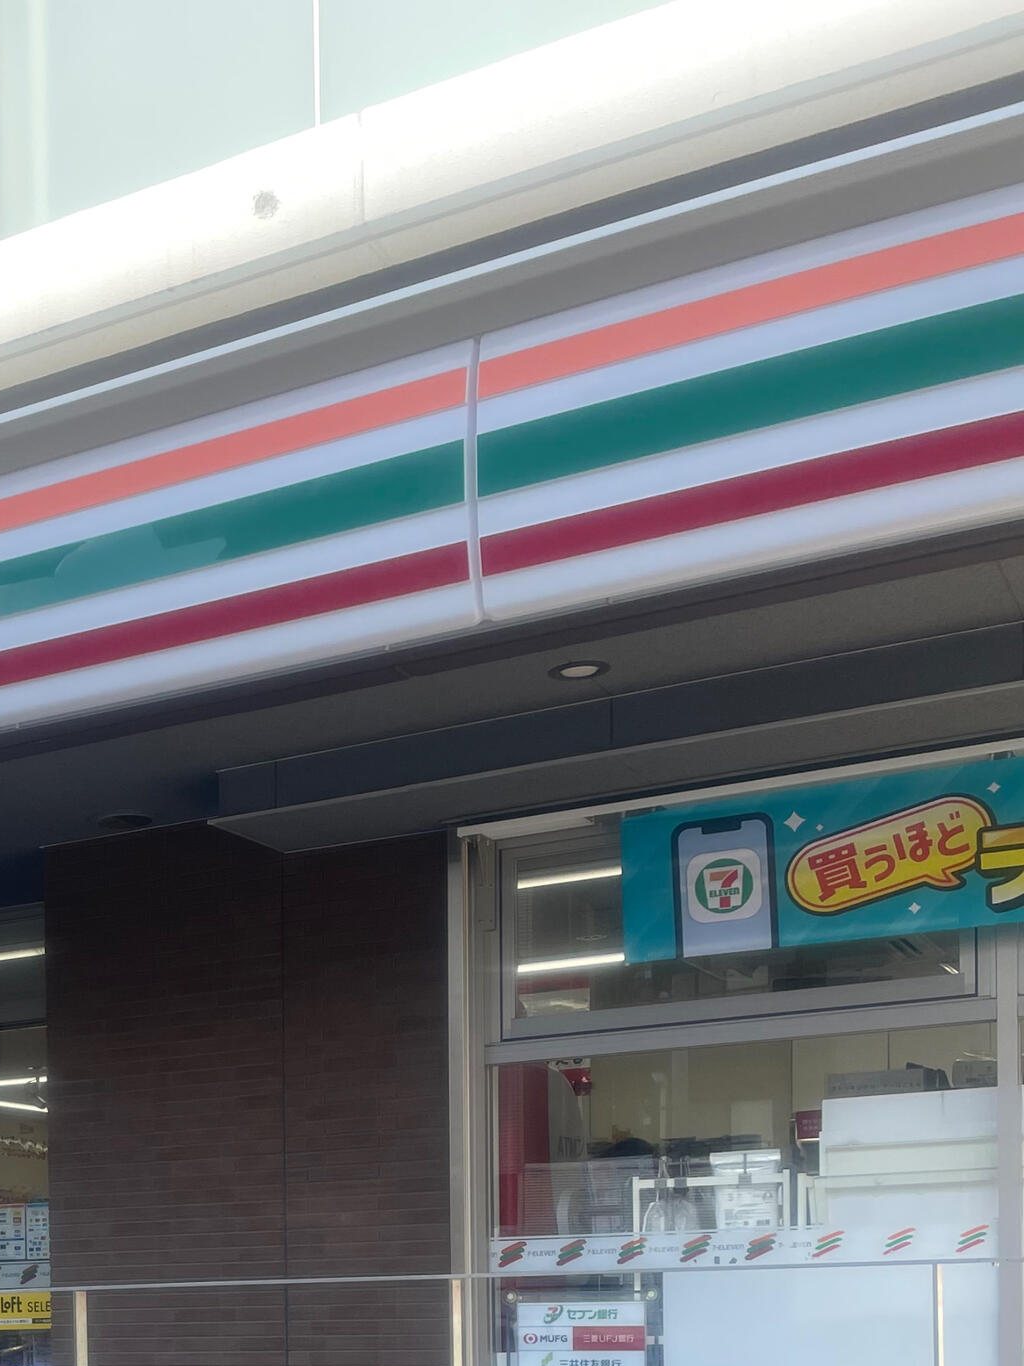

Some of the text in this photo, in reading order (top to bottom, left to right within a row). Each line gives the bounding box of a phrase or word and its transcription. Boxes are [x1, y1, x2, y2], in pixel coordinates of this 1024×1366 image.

[808, 811, 970, 902] 買うほど
[566, 1309, 618, 1320] セブン銀行
[539, 1334, 568, 1343] MUFG
